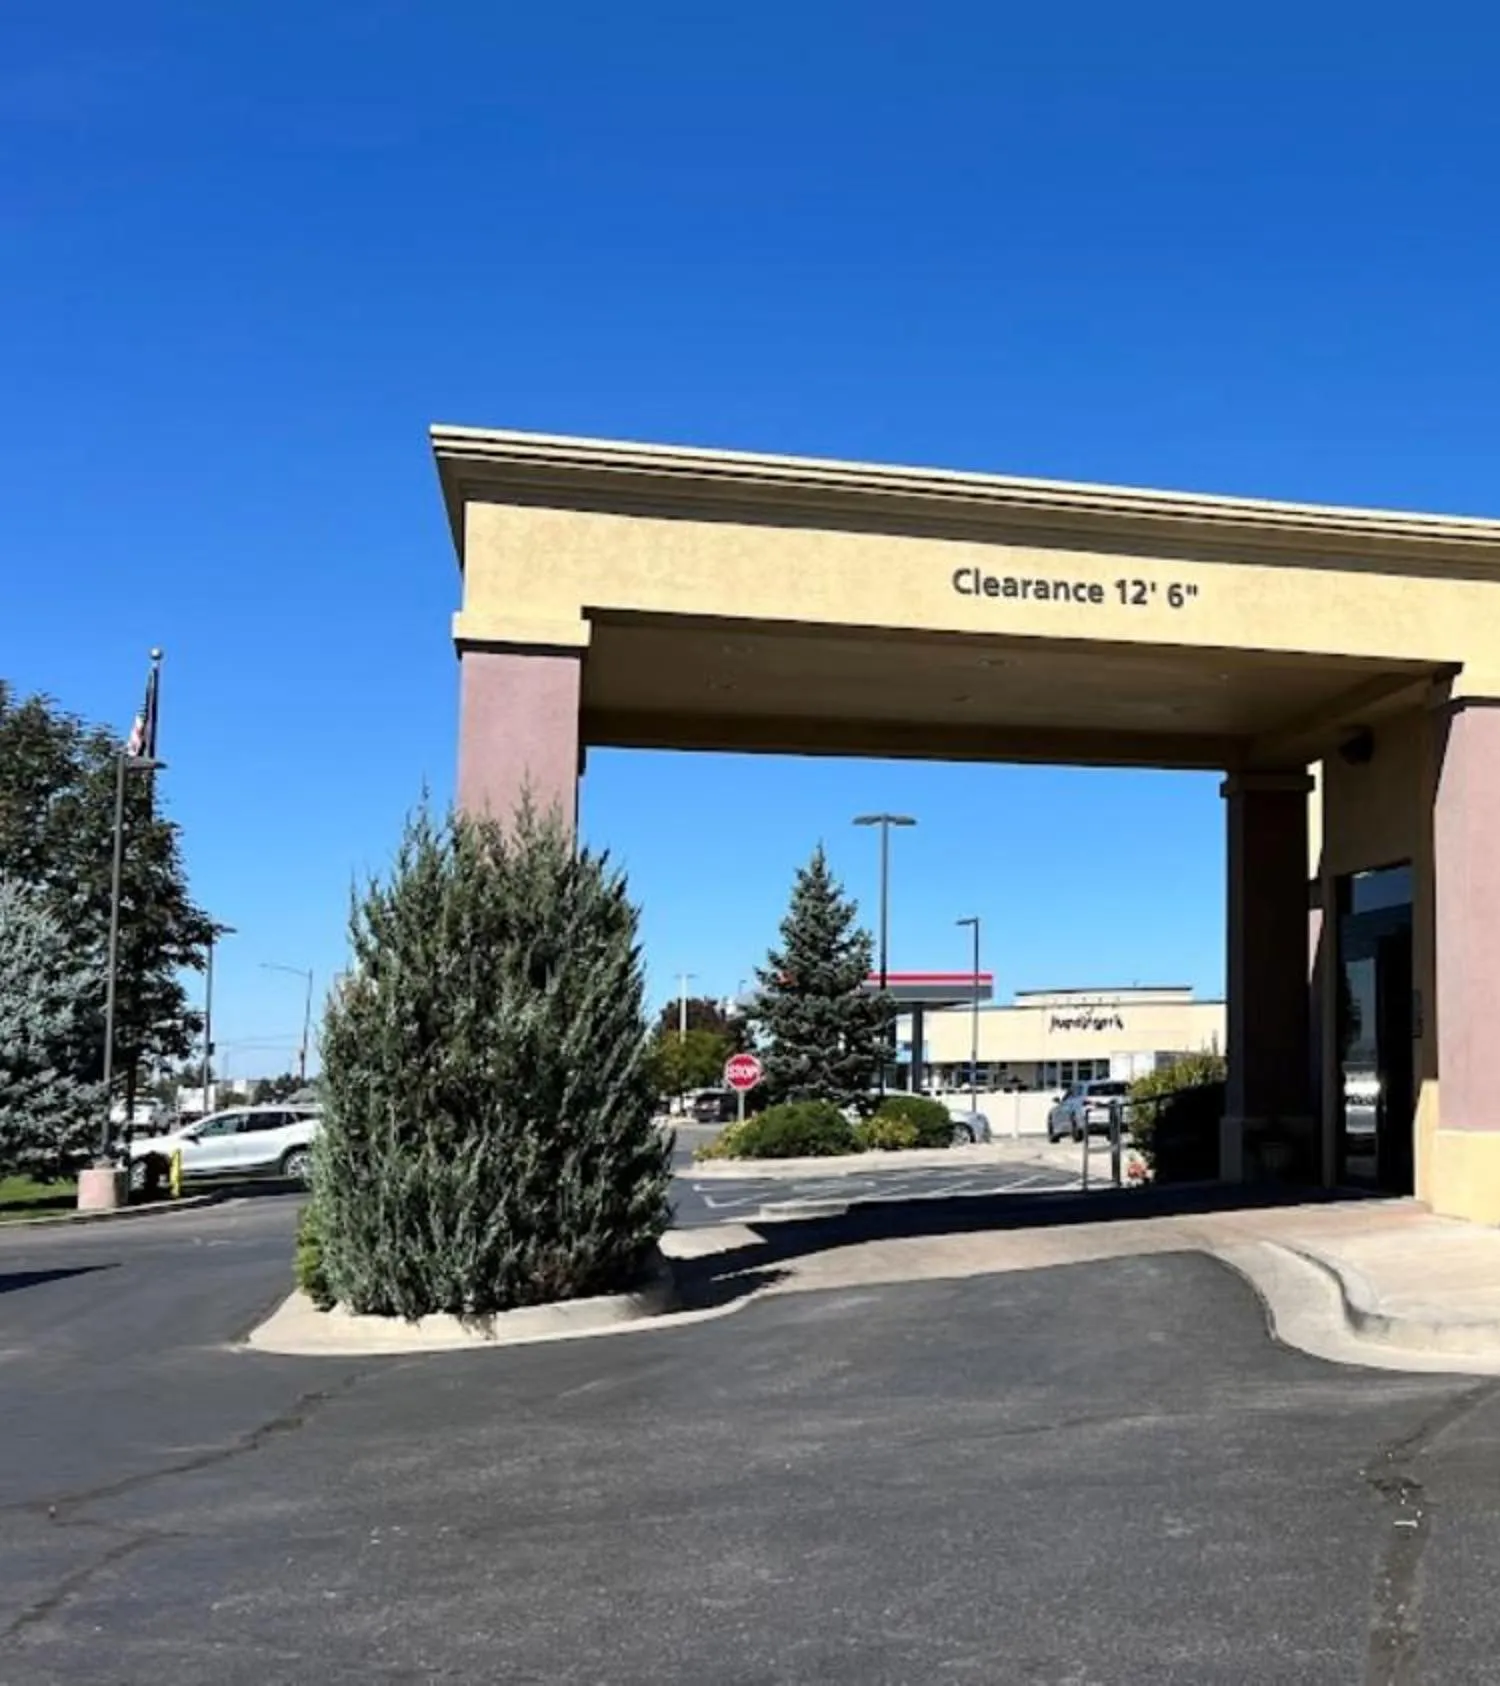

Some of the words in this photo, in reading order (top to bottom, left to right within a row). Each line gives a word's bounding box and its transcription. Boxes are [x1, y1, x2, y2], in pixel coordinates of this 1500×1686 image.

[952, 568, 1104, 603] Clearance
[1115, 579, 1156, 605] 12'
[1167, 583, 1198, 609] 6"
[728, 1064, 758, 1079] STOP
